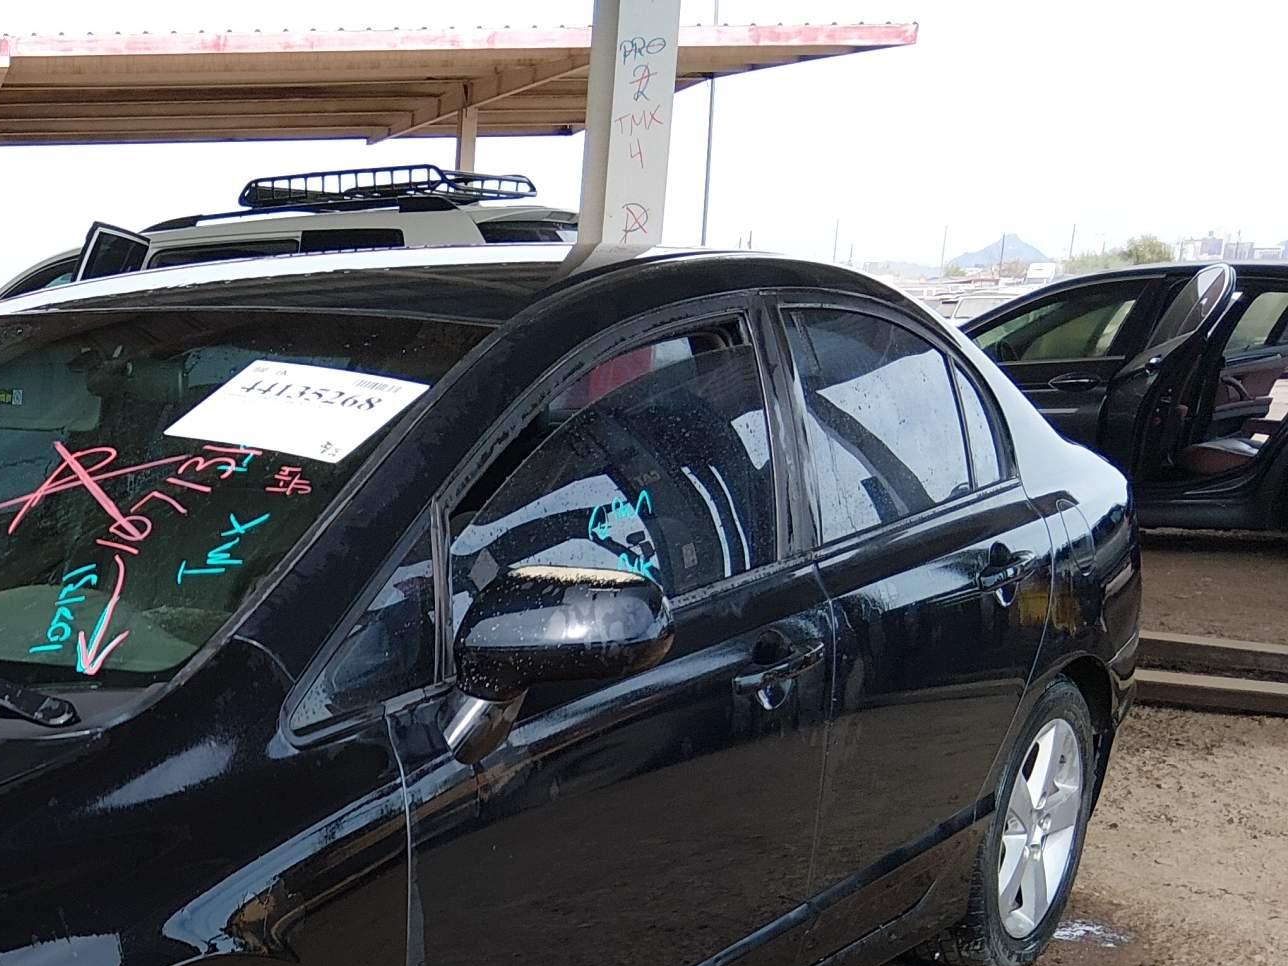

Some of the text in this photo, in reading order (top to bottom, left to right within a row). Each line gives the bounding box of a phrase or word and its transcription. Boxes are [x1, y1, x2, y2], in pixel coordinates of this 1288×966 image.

[615, 104, 663, 136] TMX
[629, 139, 644, 168] 4
[240, 380, 383, 411] 44135268
[177, 513, 270, 584] TMX
